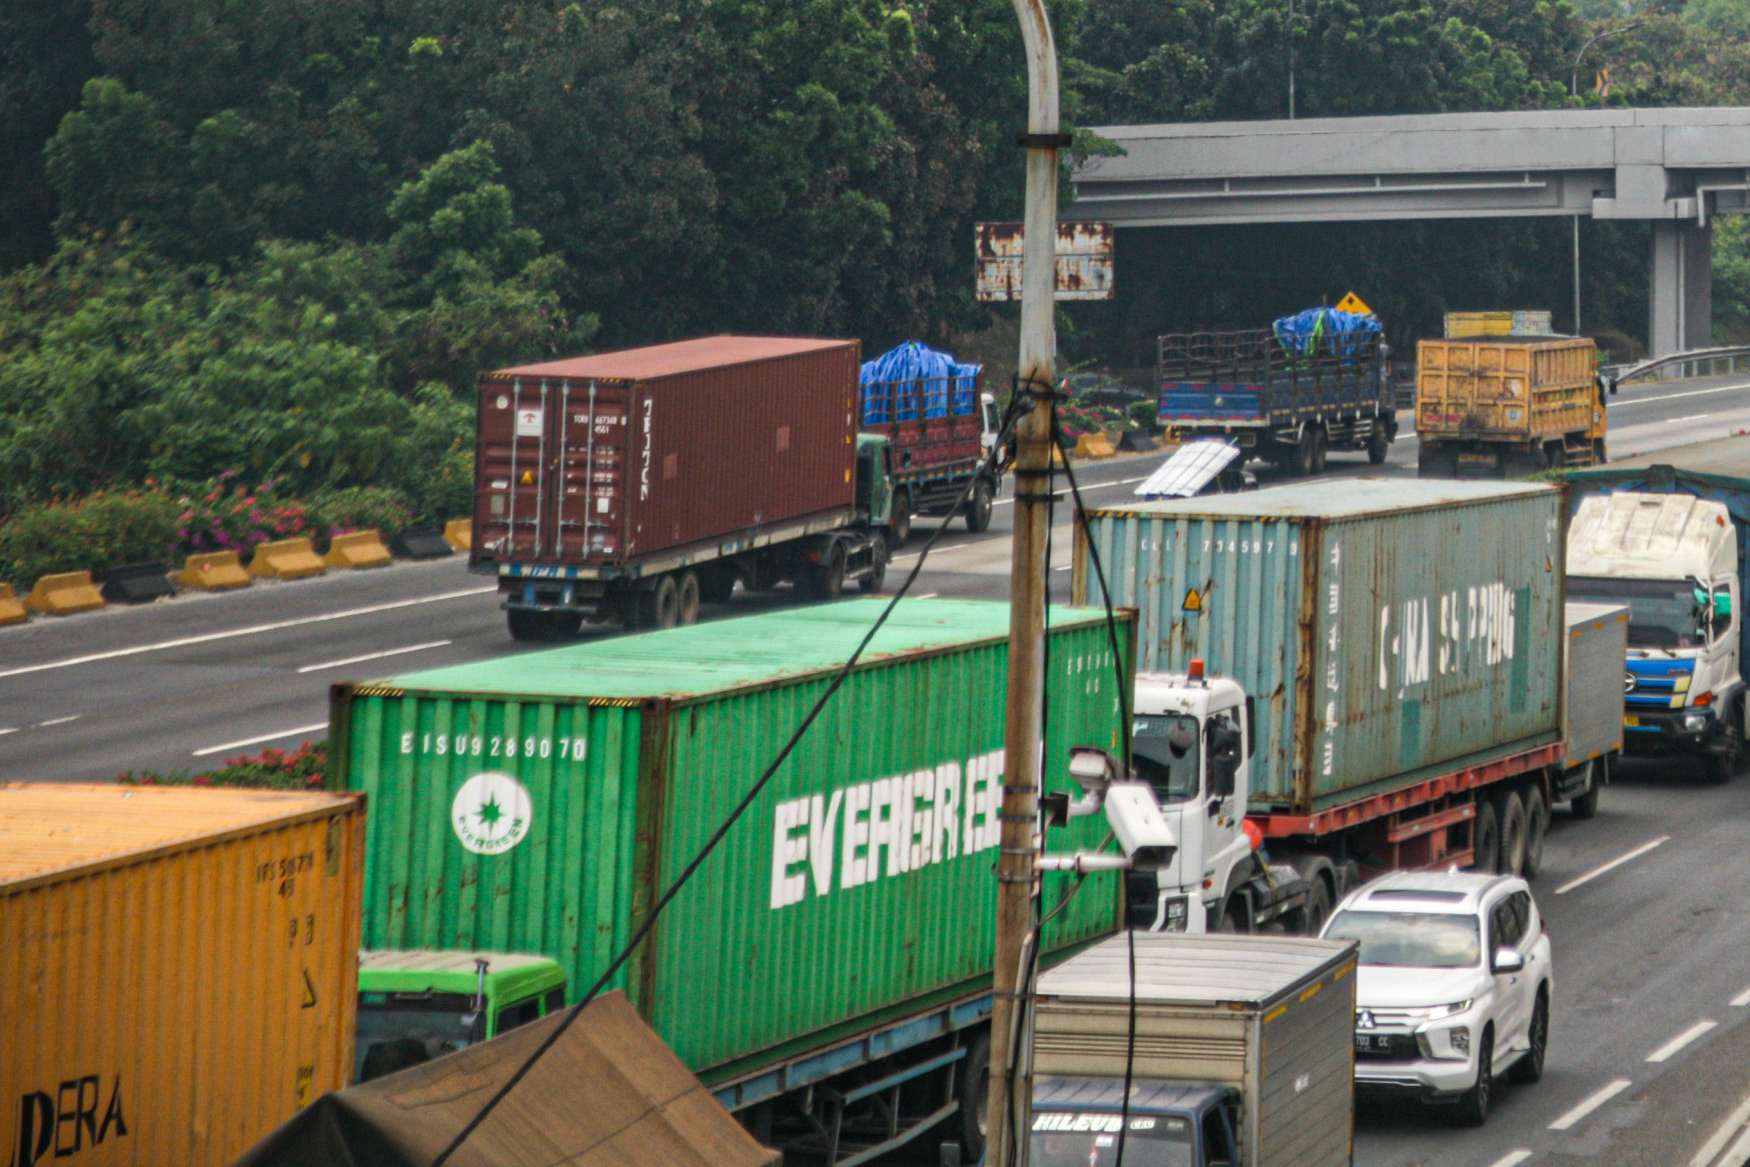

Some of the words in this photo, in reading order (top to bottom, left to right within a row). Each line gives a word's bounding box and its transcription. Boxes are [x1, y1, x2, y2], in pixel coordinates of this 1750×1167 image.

[401, 733, 586, 761] EISU9289070
[770, 749, 1006, 910] EVERGREE
[9, 1073, 128, 1167] DERA
